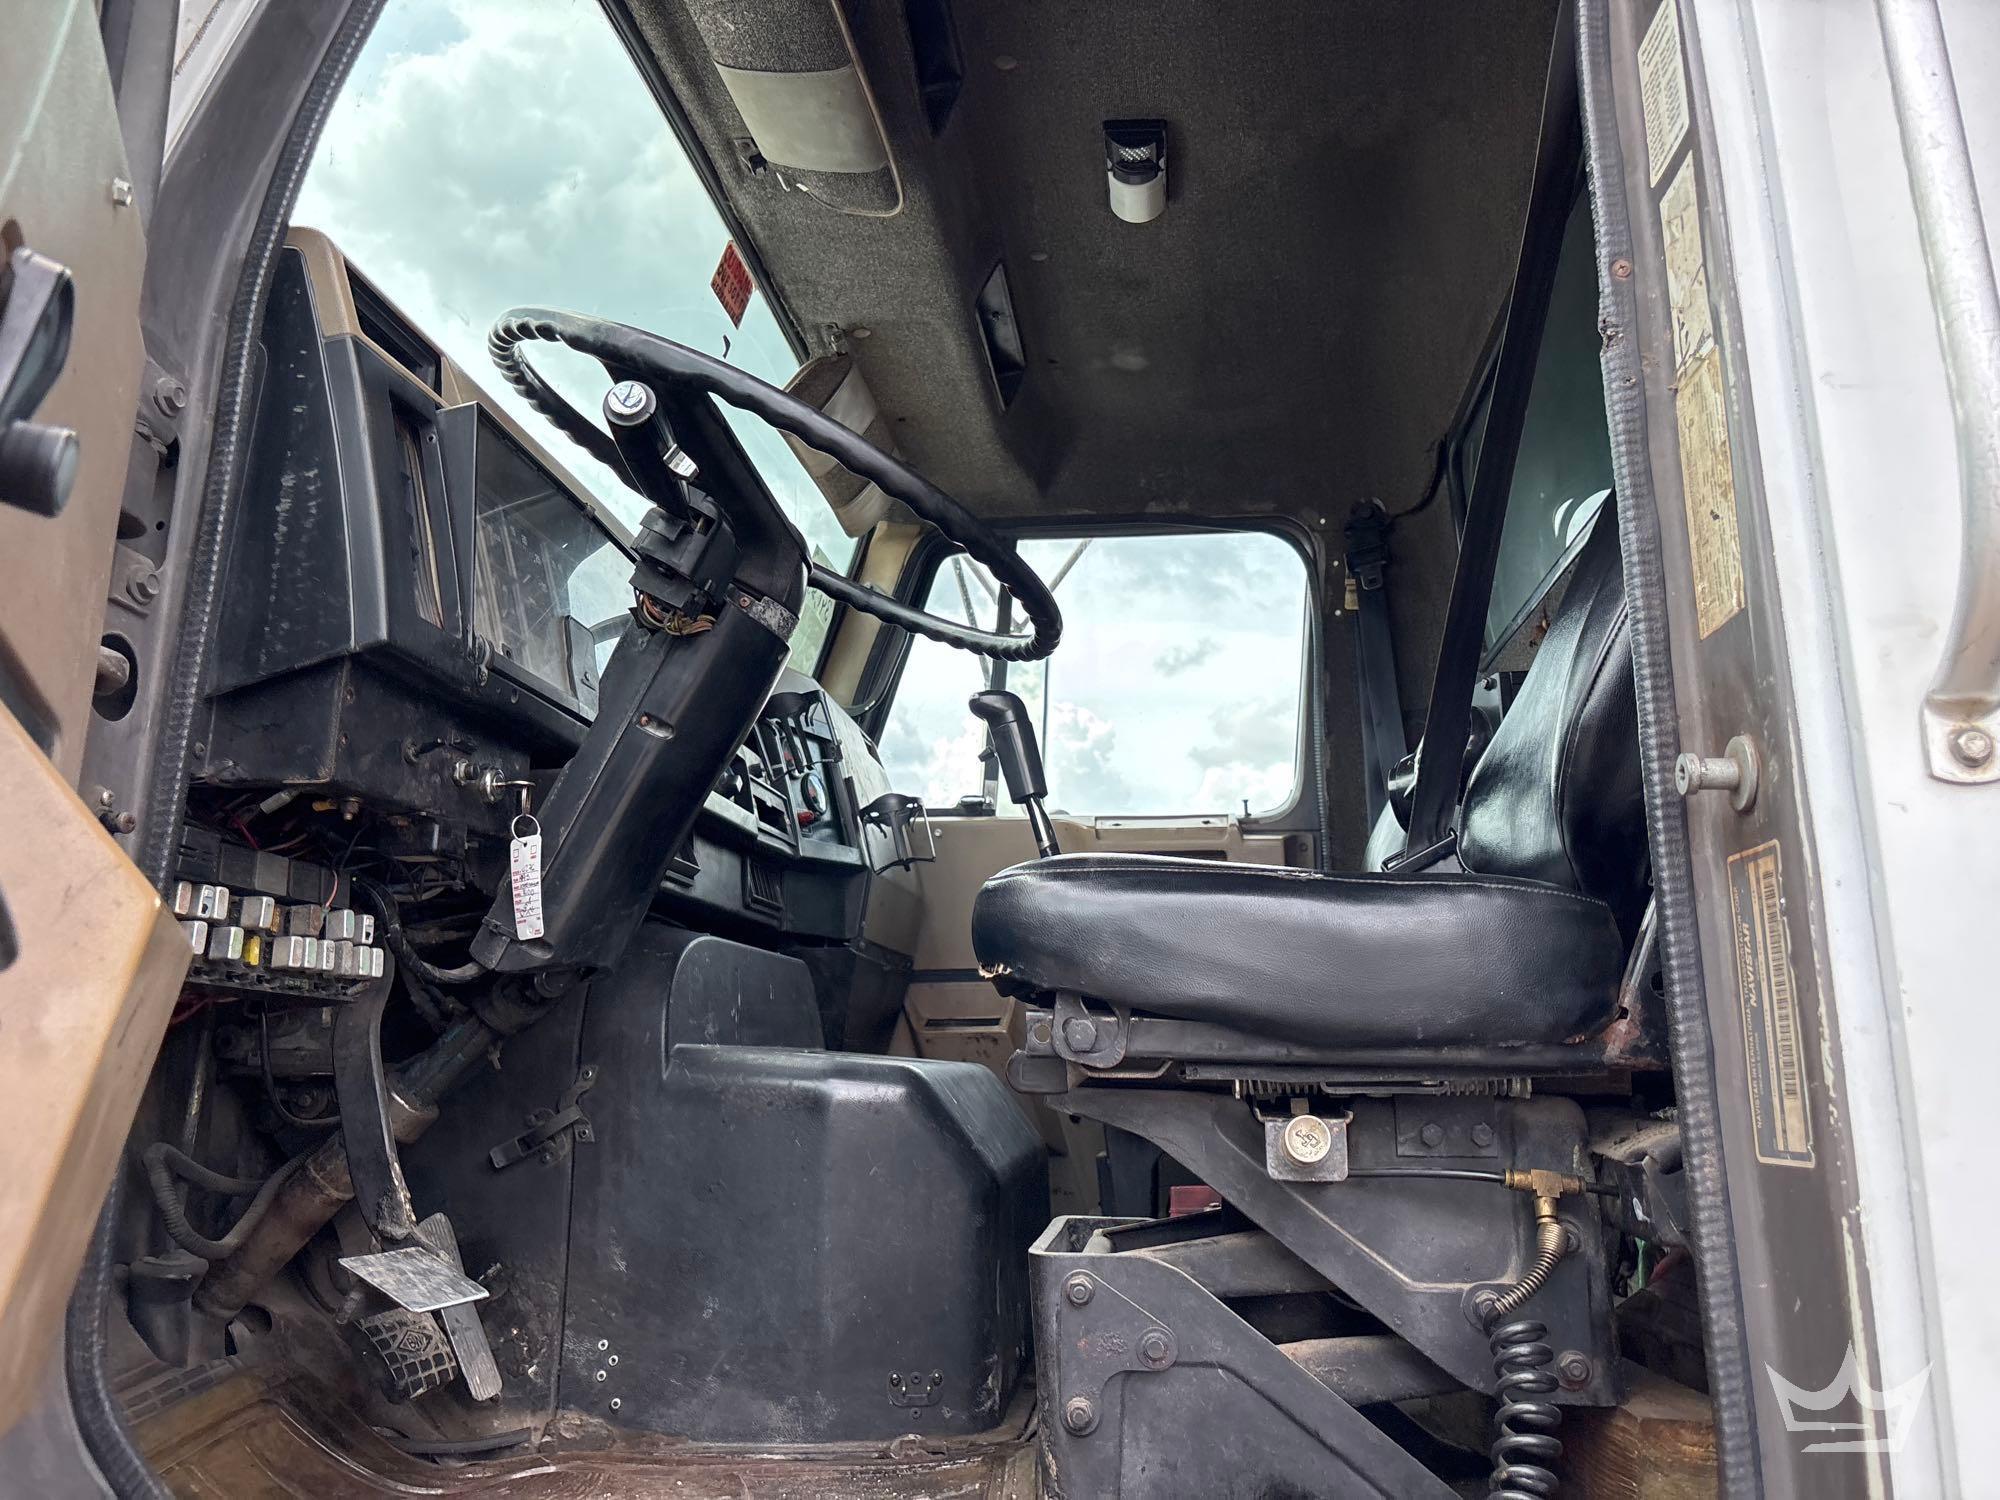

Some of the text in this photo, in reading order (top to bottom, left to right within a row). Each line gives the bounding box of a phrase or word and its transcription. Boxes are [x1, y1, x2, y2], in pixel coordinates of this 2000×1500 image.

[1742, 922, 1758, 1007] NAVISTAR
[1745, 1000, 1757, 1078] INTERNATIONAL
[1752, 1080, 1762, 1128] NAVISTAR
